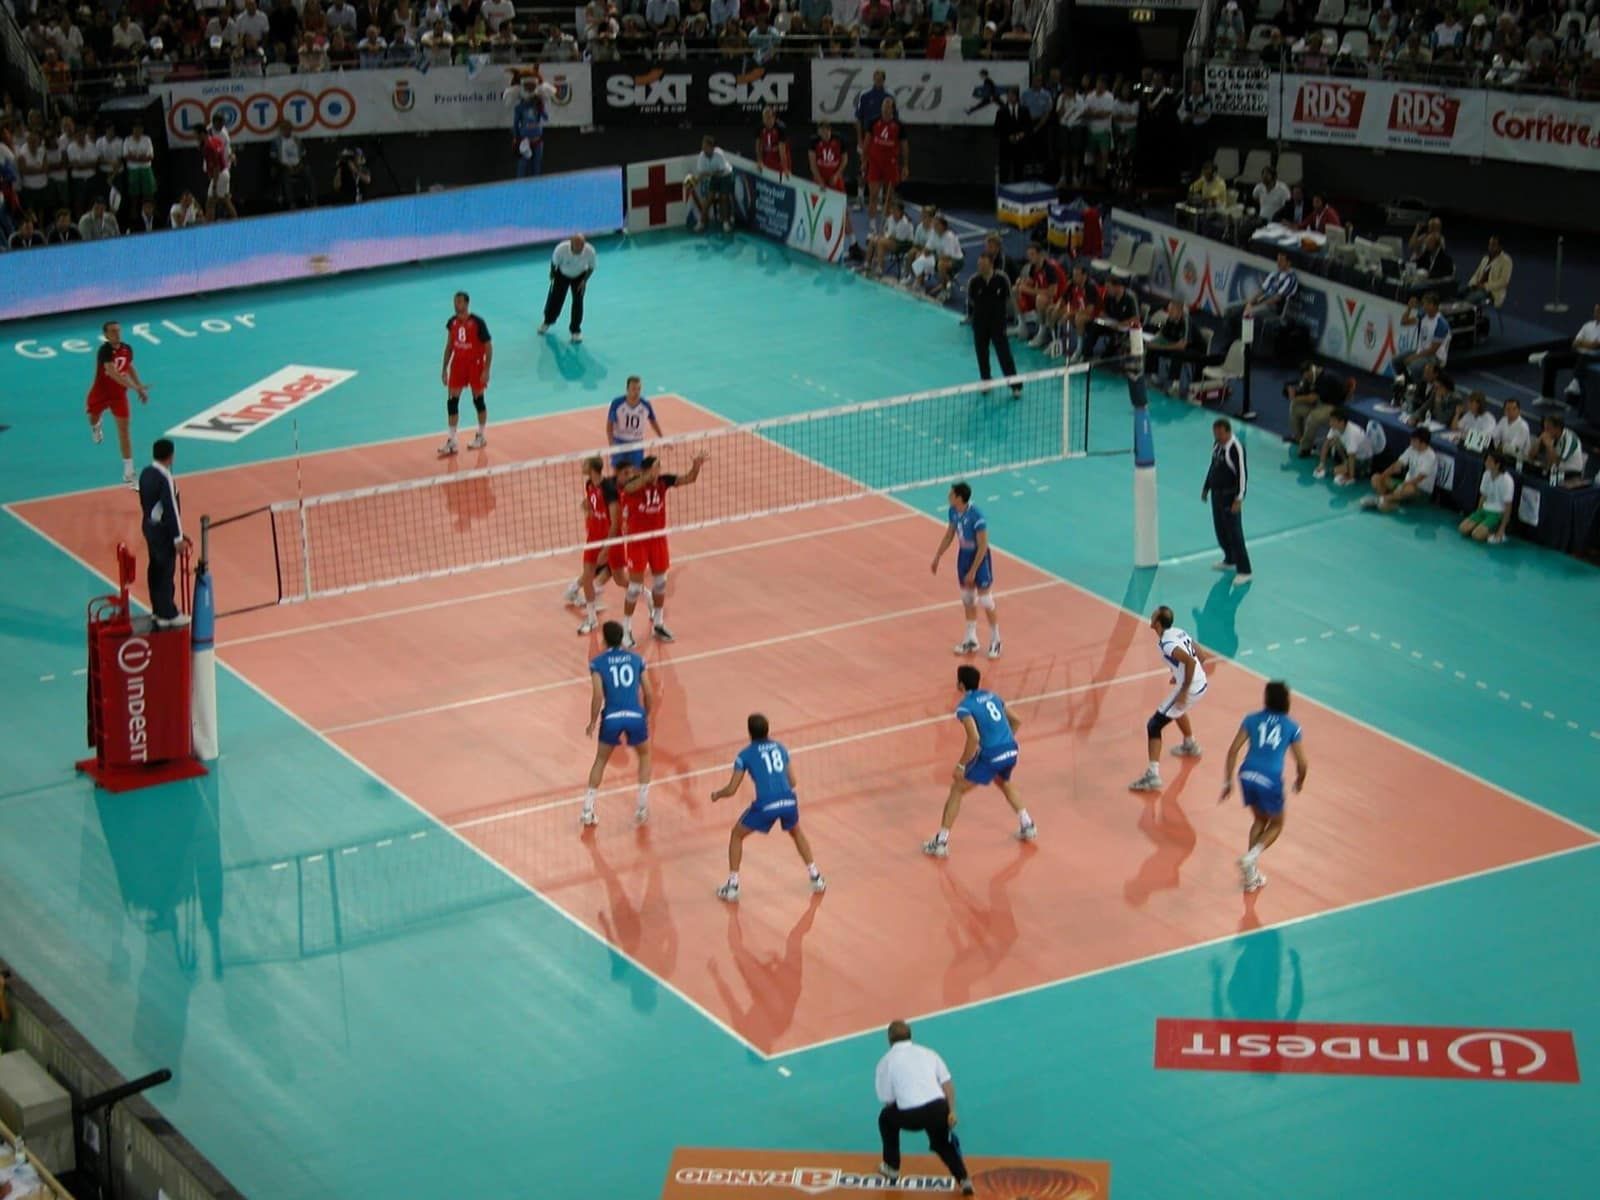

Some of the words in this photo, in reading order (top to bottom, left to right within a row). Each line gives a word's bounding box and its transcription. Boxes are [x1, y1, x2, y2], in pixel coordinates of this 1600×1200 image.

[168, 87, 356, 141] LOTTO
[1302, 83, 1352, 119] RDS
[1397, 91, 1446, 127] RDS
[1493, 109, 1591, 148] Corriere
[14, 312, 257, 359] Geflor
[182, 373, 333, 434] Kinder
[624, 415, 640, 429] 10
[609, 663, 634, 688] 10
[986, 700, 1002, 722] 8
[1258, 721, 1282, 750] 14
[761, 749, 784, 775] 18
